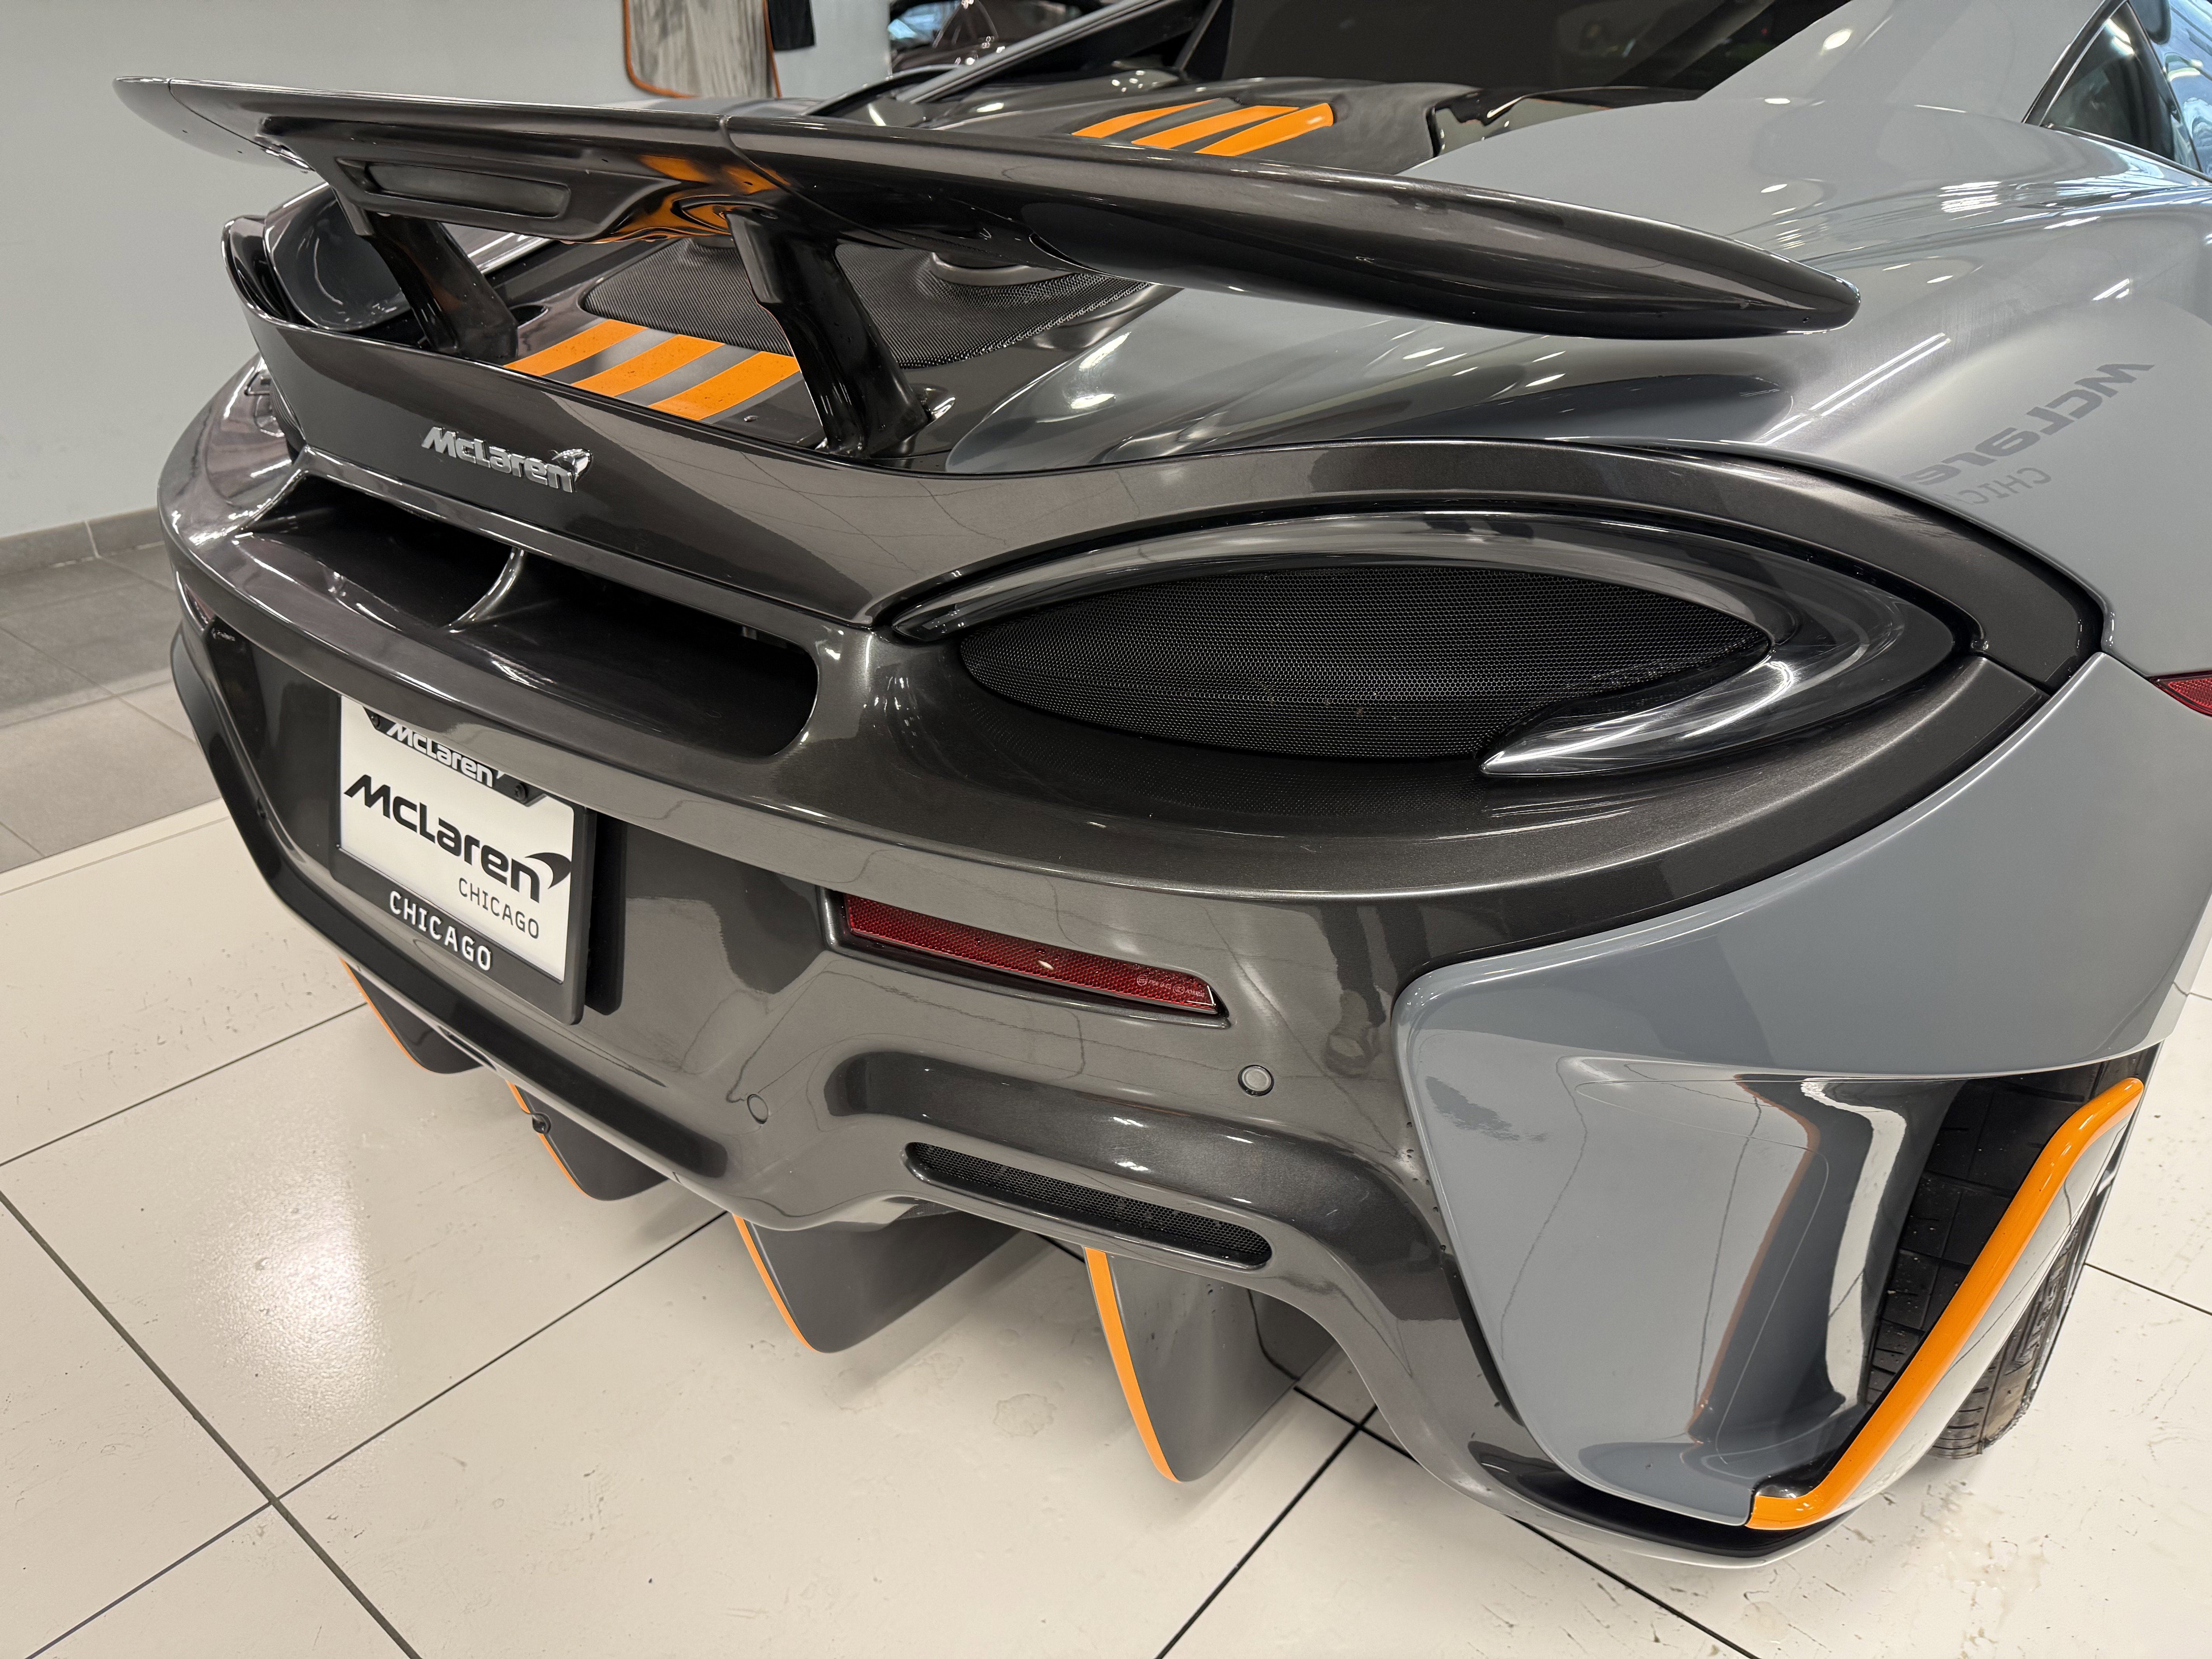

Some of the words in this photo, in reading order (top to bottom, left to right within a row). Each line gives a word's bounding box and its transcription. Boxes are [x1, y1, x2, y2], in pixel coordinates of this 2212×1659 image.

[421, 426, 575, 493] McLaren
[386, 723, 493, 788] McLaren
[343, 775, 540, 903] McLaren
[390, 890, 492, 971] CHICAGO
[459, 877, 539, 939] CHICAGO
